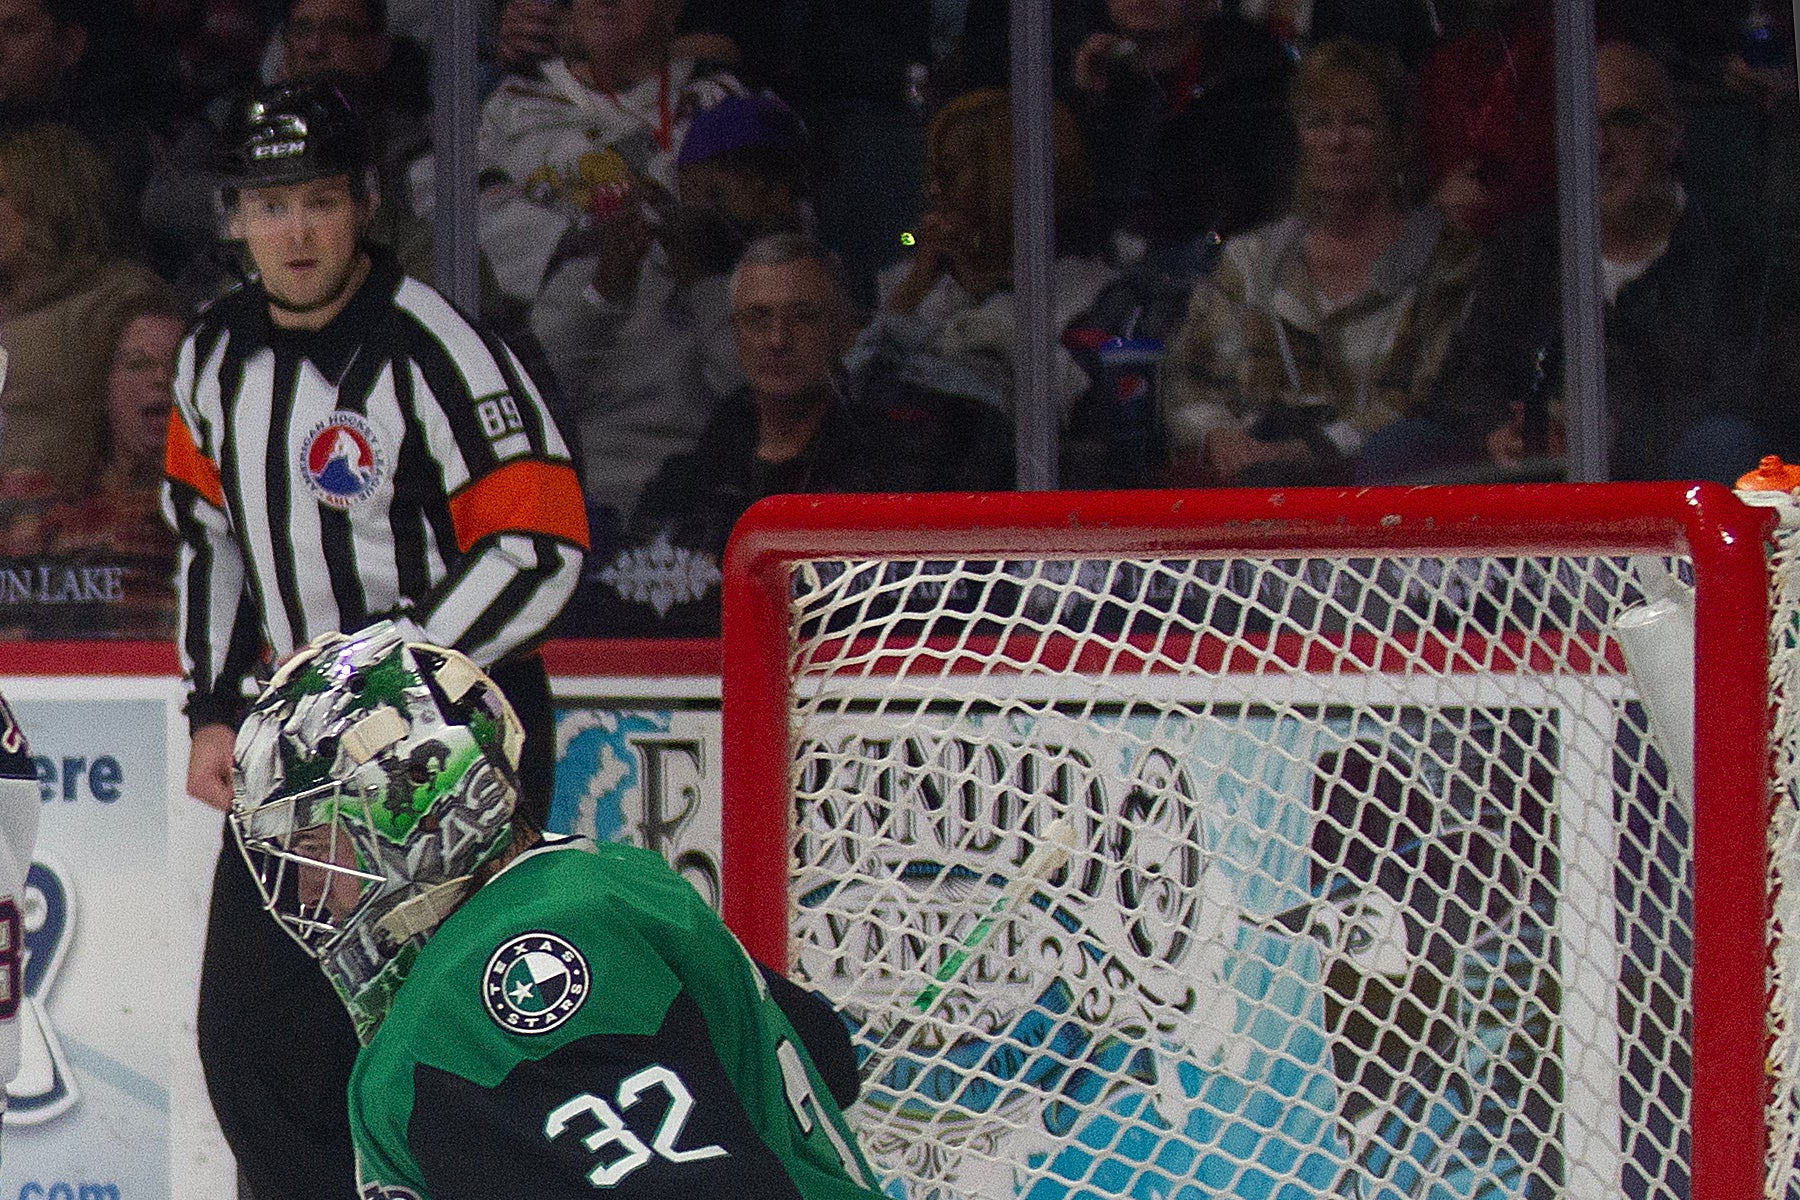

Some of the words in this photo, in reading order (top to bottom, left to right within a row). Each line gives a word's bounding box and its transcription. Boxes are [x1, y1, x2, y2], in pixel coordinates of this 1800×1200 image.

[253, 141, 306, 158] CCM
[478, 395, 524, 438] 89
[37, 566, 125, 602] LAKE
[489, 940, 576, 996] TEXAS
[506, 983, 583, 1029] STARS
[542, 1062, 732, 1189] 32
